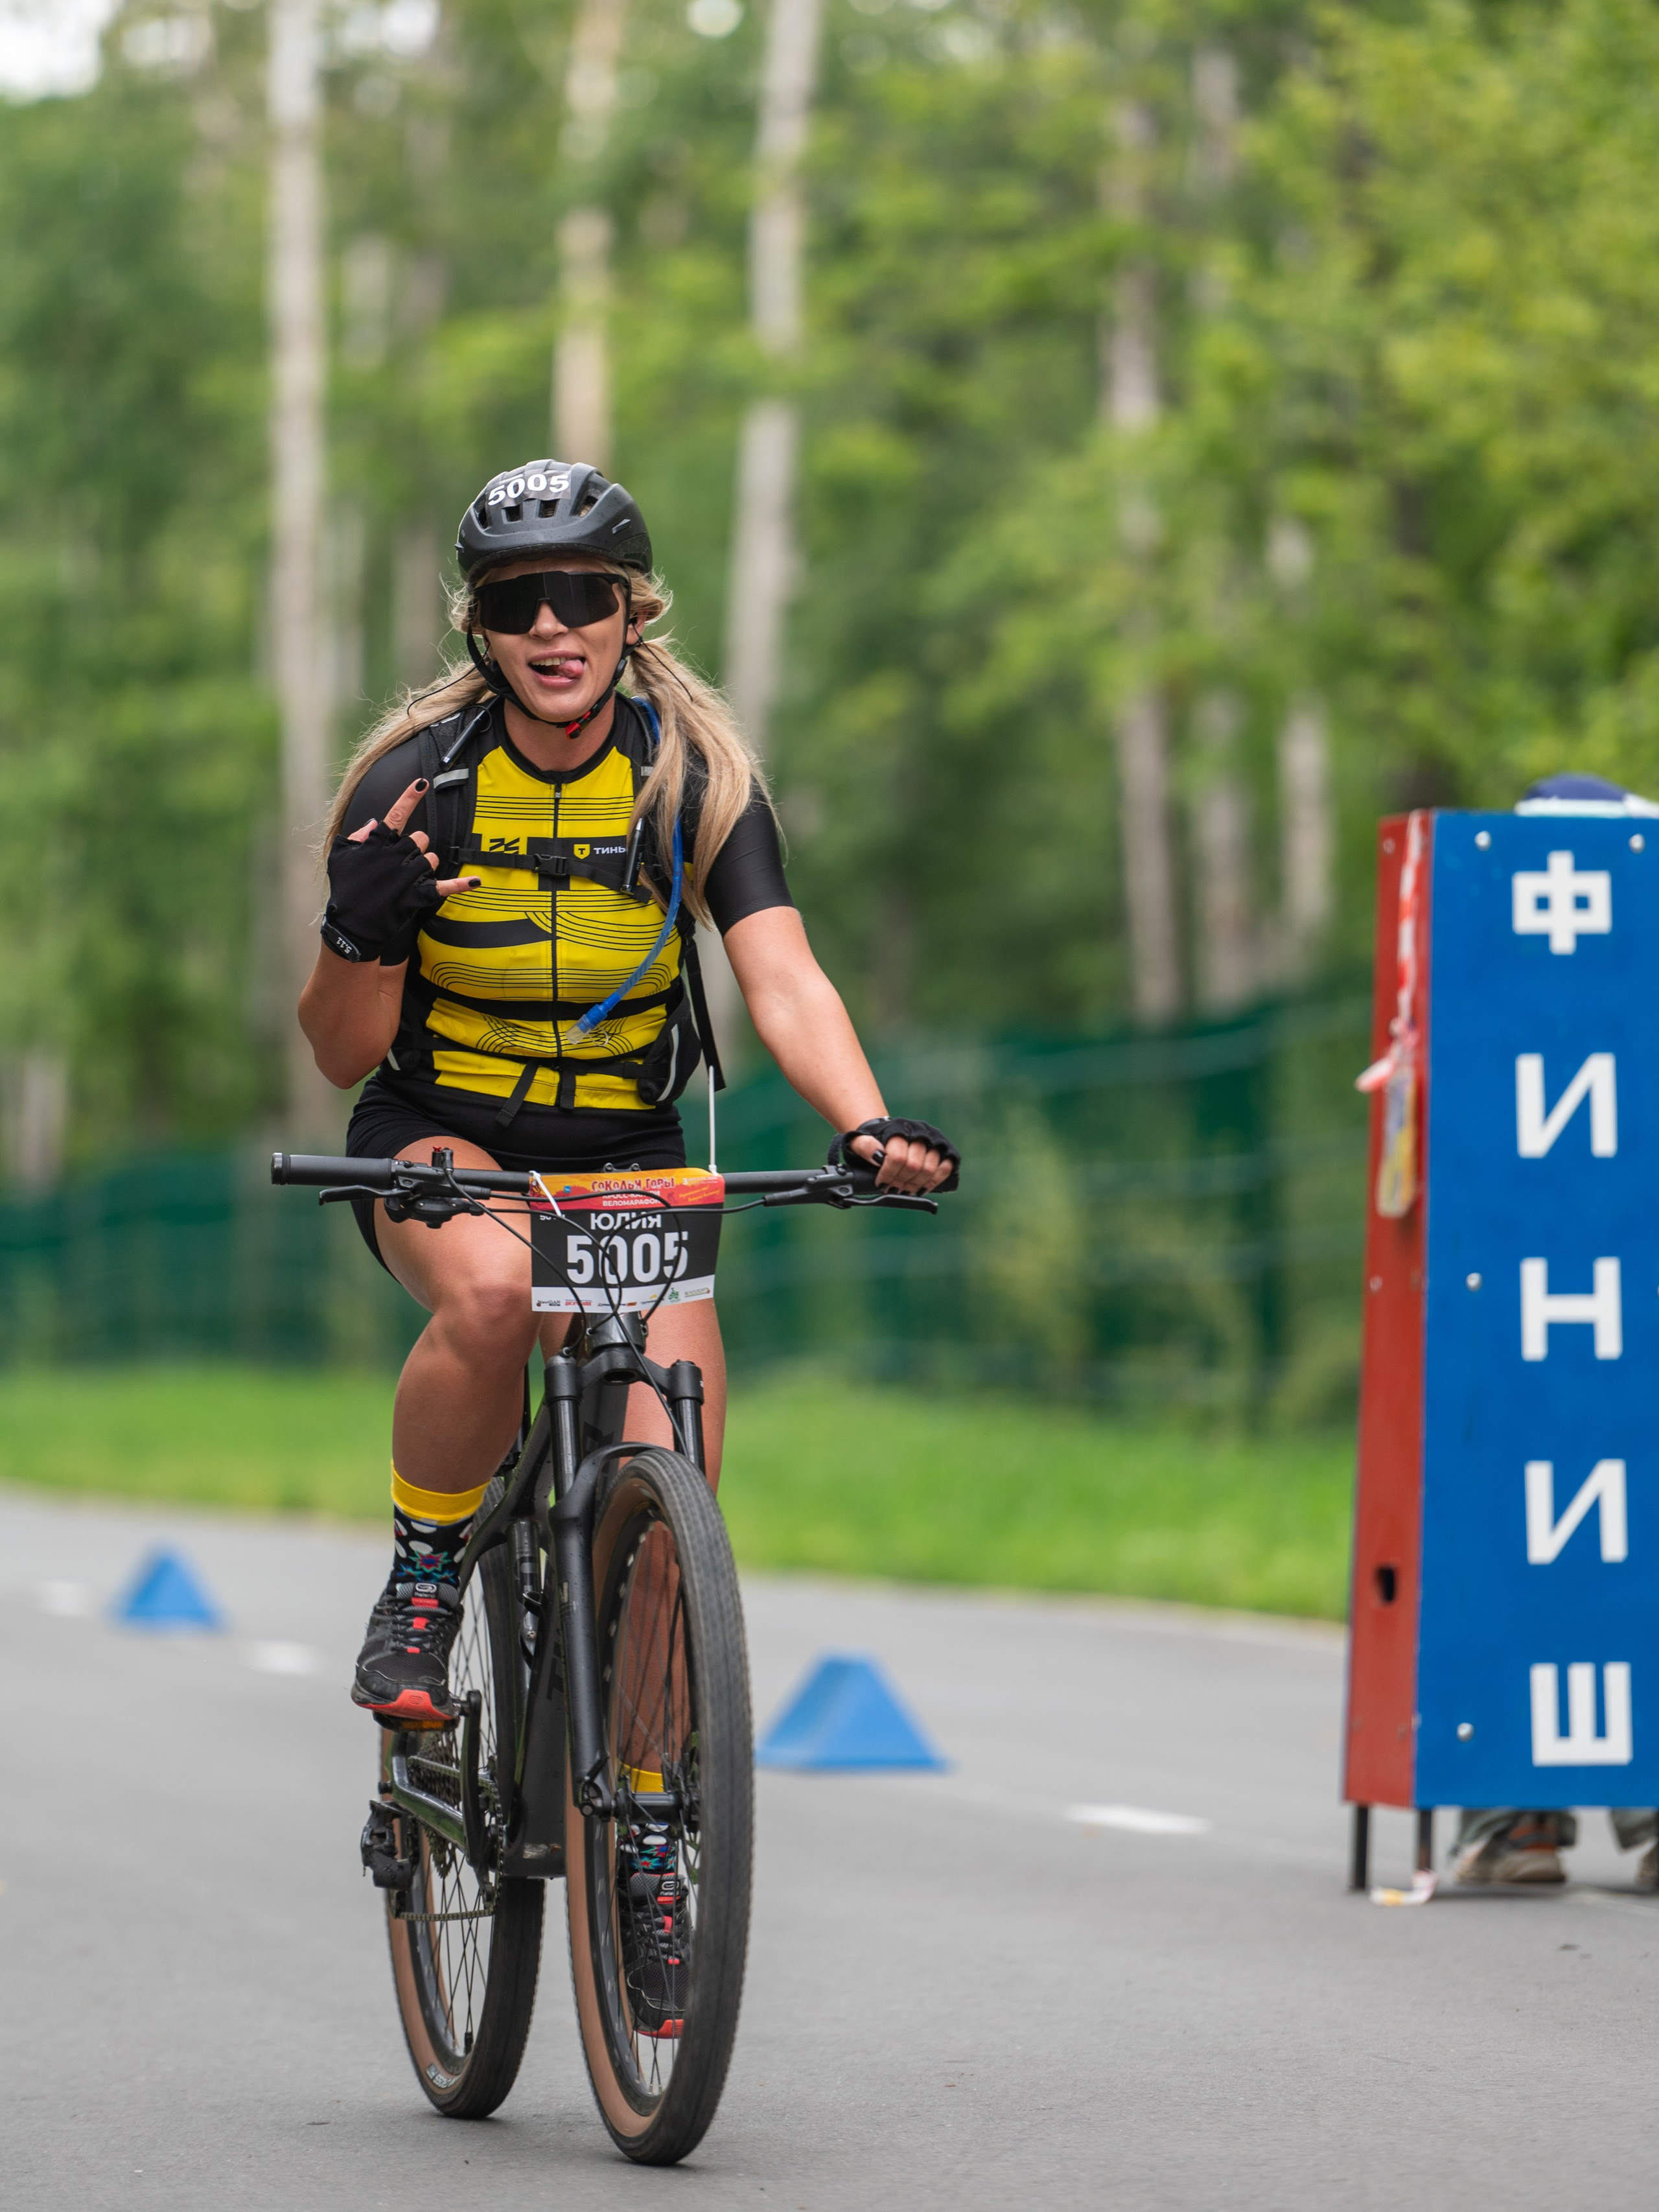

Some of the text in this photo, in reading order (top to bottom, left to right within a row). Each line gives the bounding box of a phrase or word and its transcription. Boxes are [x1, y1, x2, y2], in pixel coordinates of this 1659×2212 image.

[488, 473, 570, 506] 5005
[336, 937, 352, 954] 5.11
[590, 1211, 662, 1230] ЮЛИЯ
[566, 1231, 688, 1285] 5005
[1511, 850, 1634, 1767] ФИНИШ
